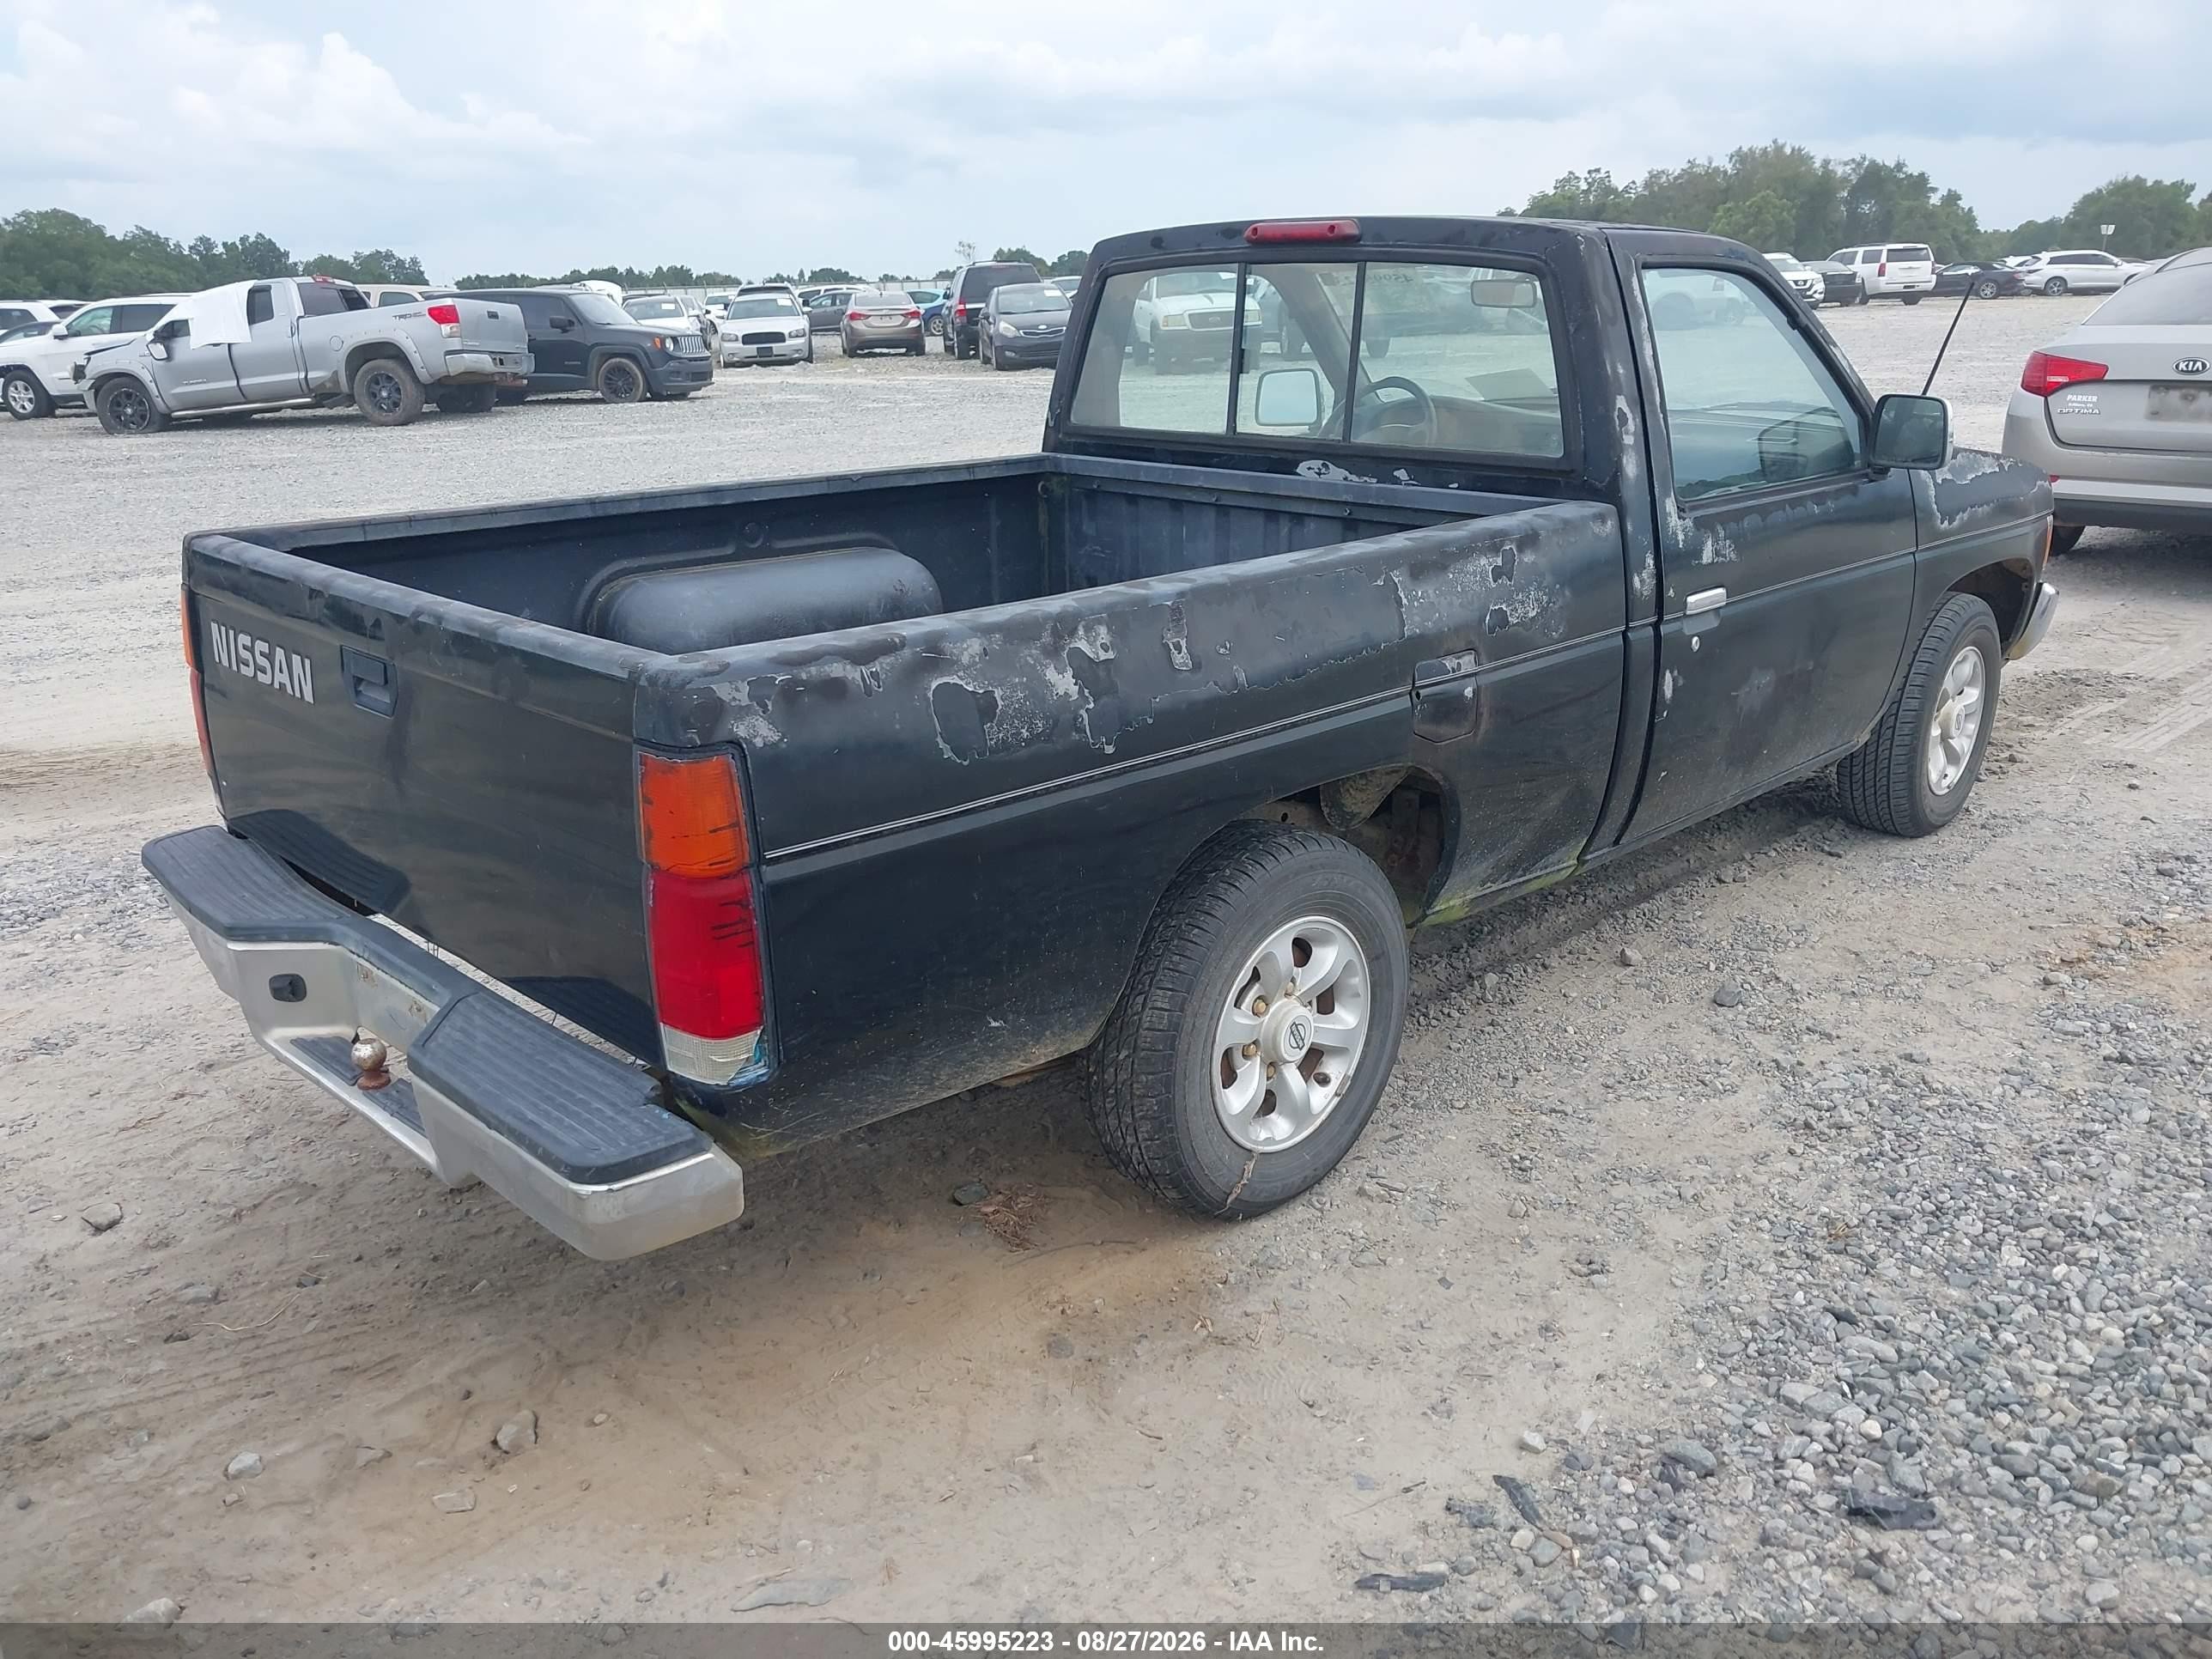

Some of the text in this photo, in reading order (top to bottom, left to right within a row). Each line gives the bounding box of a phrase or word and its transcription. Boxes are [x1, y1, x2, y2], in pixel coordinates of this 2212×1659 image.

[2179, 361, 2203, 371] KIA
[2066, 394, 2098, 403] PARKER
[210, 620, 314, 704] NISSAN
